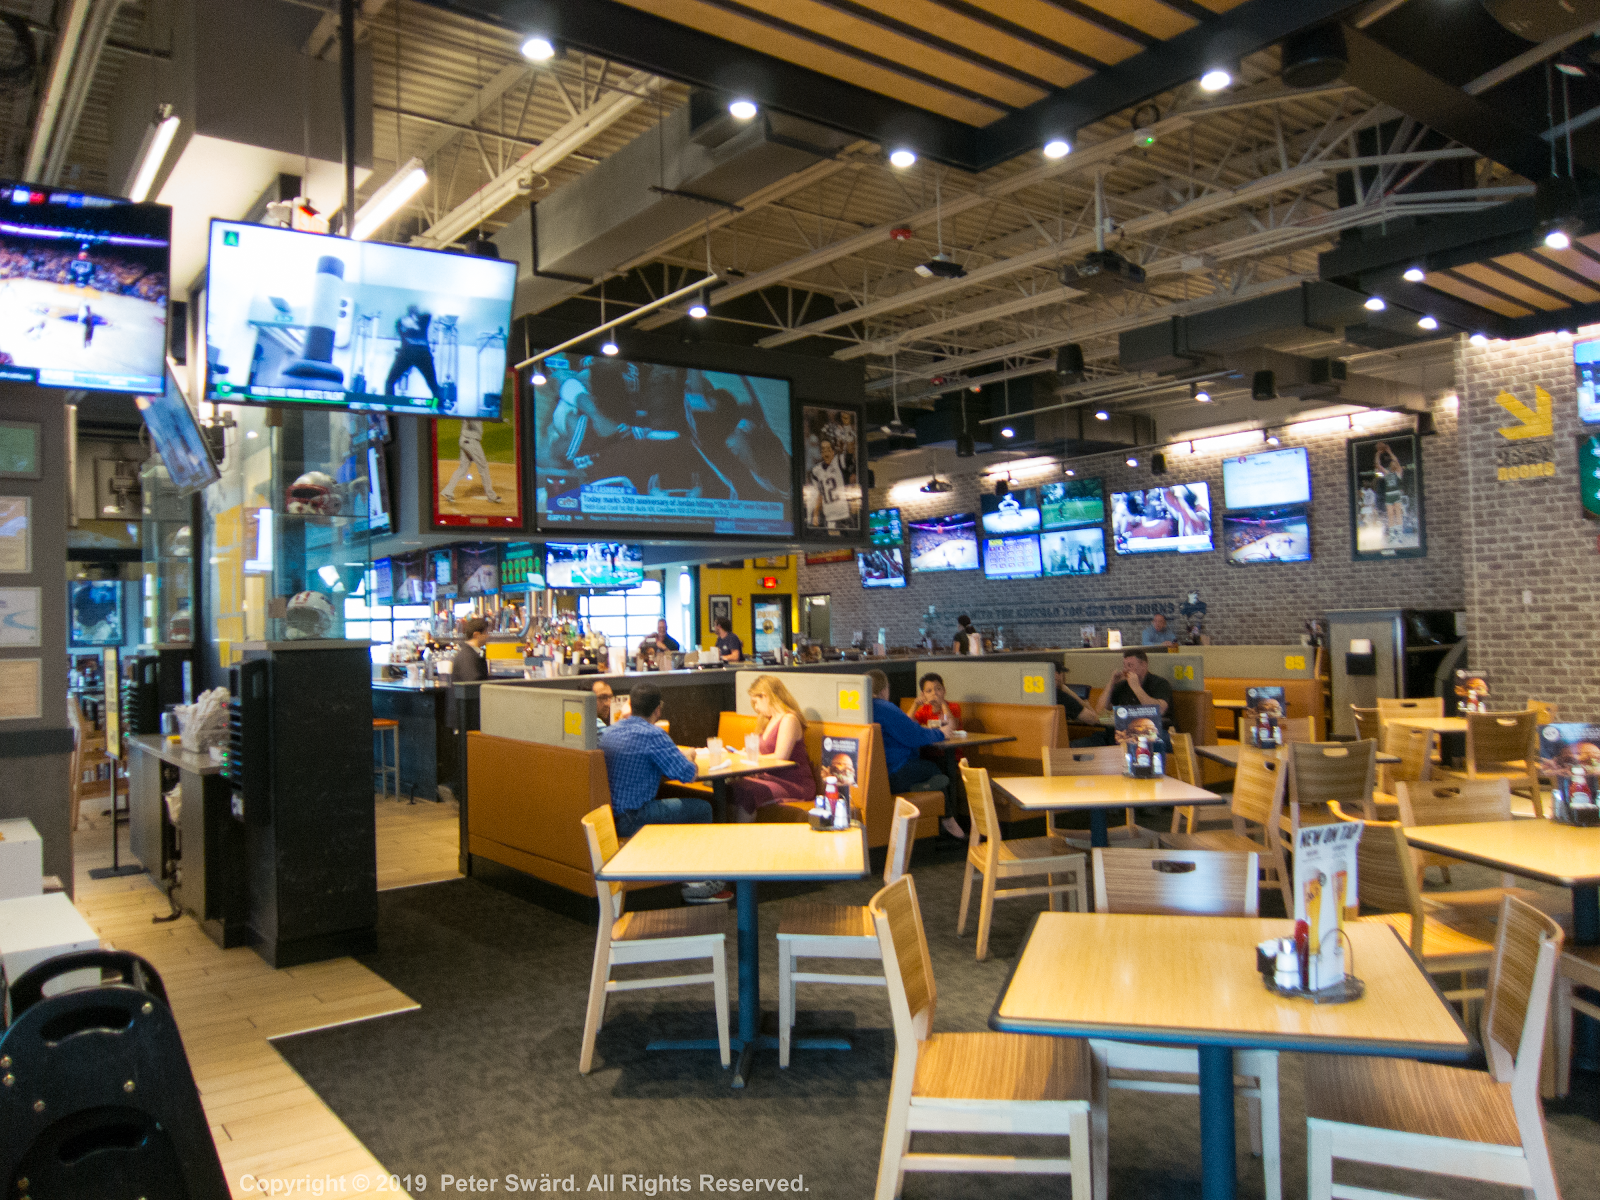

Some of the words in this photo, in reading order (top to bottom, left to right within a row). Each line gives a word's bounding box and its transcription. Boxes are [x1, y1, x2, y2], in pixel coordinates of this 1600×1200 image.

[583, 495, 601, 504] Today
[603, 496, 620, 504] marks
[1109, 604, 1133, 616] THE
[1136, 602, 1175, 615] HORNS
[1285, 655, 1306, 670] 85
[1174, 665, 1194, 680] 84
[1023, 675, 1045, 693] 83
[838, 689, 860, 710] 82
[564, 711, 582, 735] 82
[1300, 829, 1324, 848] NEW
[1323, 826, 1339, 843] ON
[1340, 823, 1360, 840] TAP
